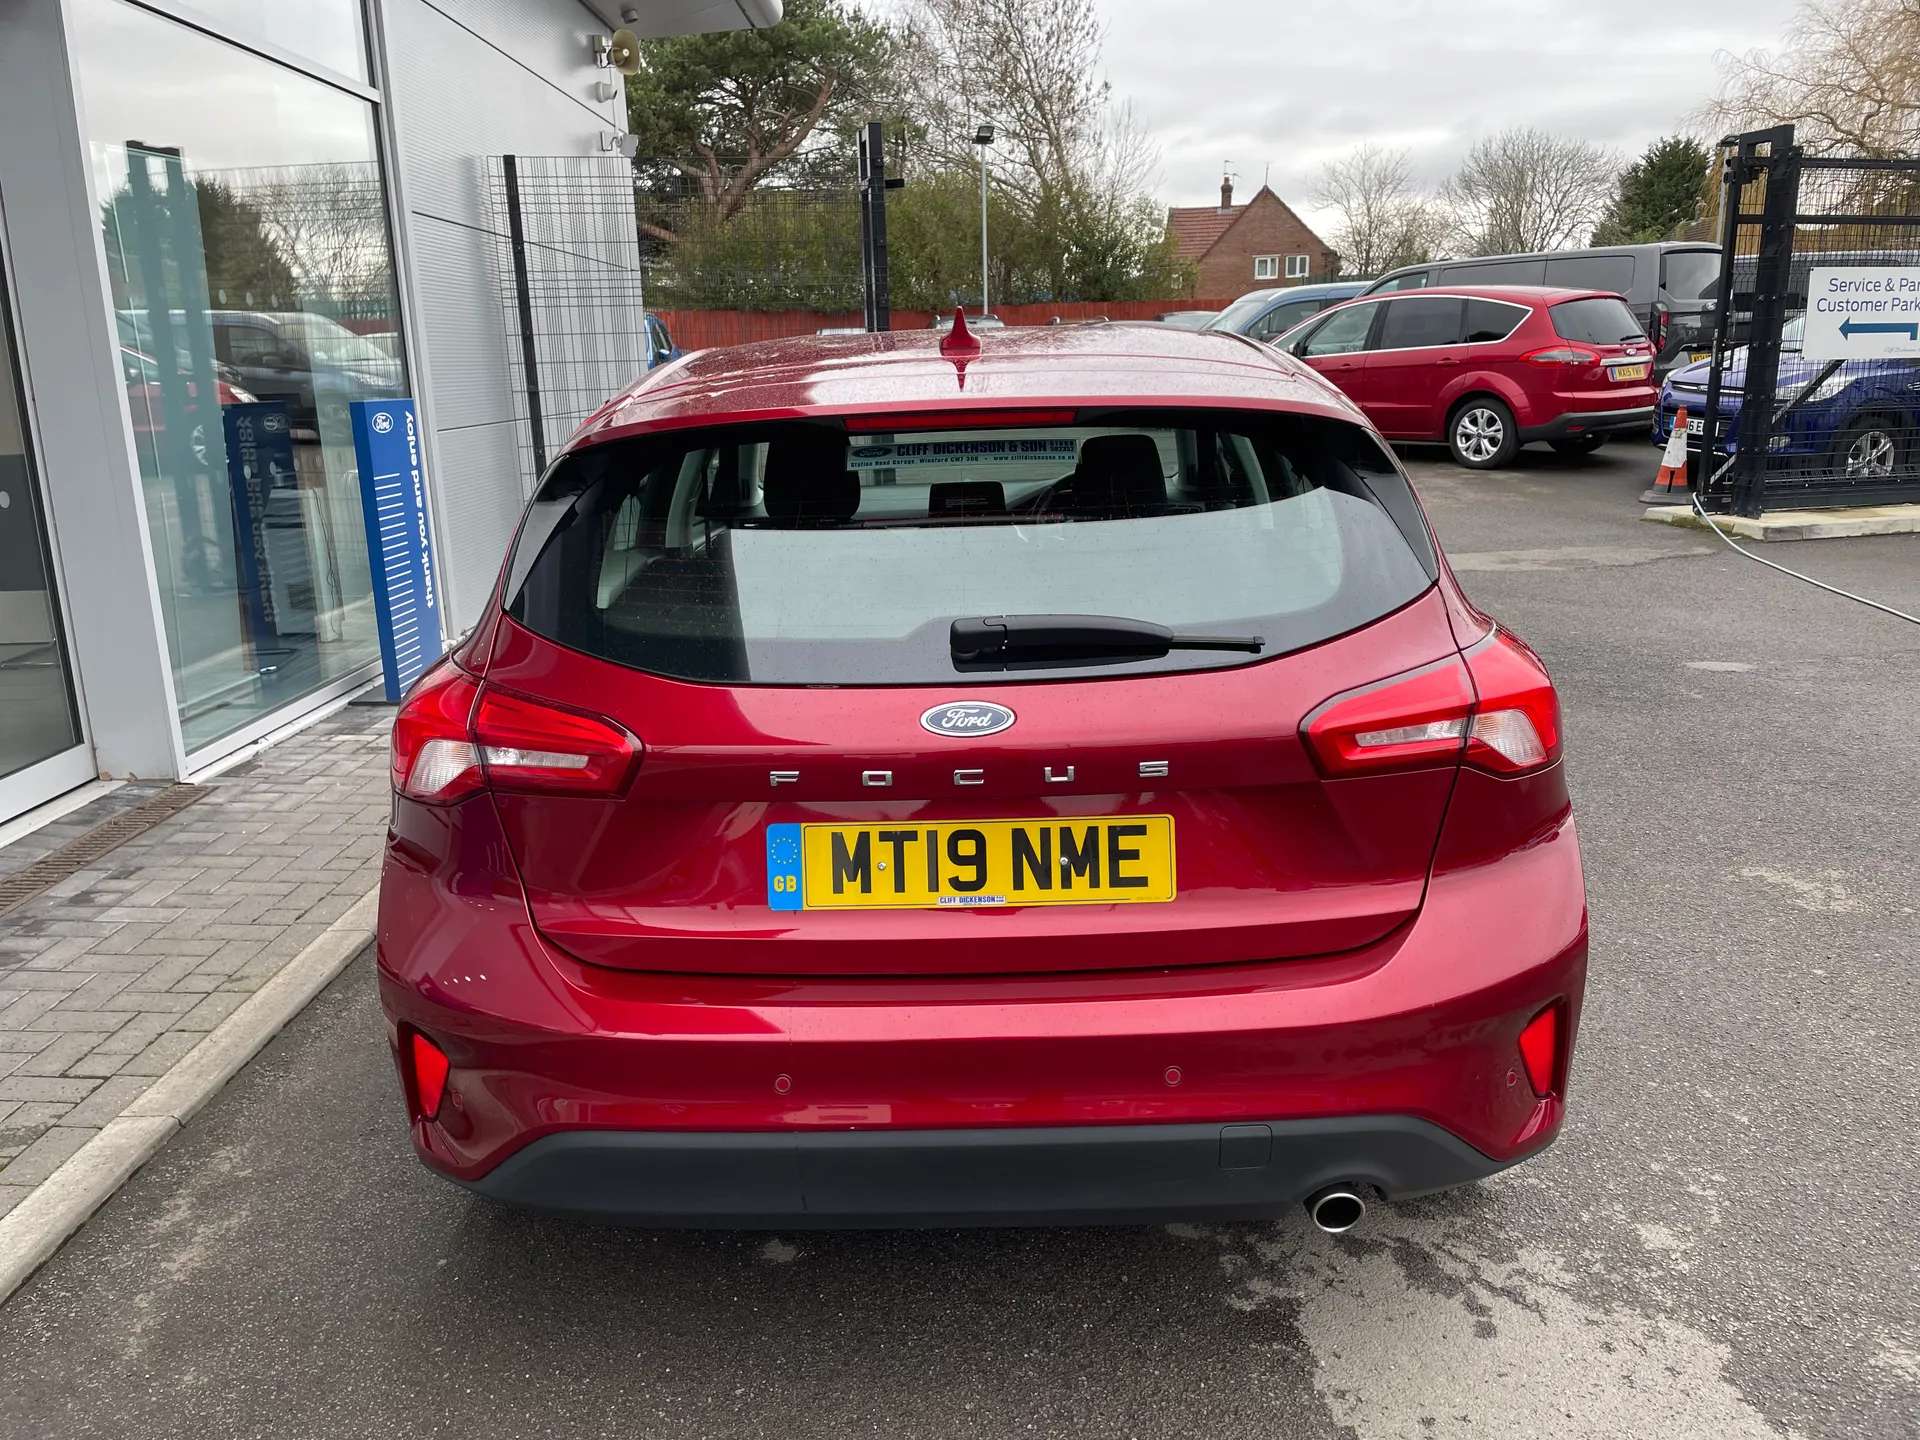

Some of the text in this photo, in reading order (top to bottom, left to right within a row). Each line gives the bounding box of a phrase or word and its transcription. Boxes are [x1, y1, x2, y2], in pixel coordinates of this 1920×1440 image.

[1828, 277, 1881, 292] Service
[1884, 277, 1895, 292] &
[1816, 297, 1888, 312] Customer
[896, 443, 931, 457] CLIFF
[933, 440, 1006, 456] DICKENSON
[1008, 440, 1018, 452] &
[1020, 439, 1047, 452] SON
[405, 410, 435, 609] thank you and enjoy
[941, 707, 993, 729] Ford
[769, 760, 1170, 787] FOCUS
[831, 824, 1149, 895] MT19 NME
[773, 874, 797, 893] GB
[940, 896, 956, 904] CLIFF
[959, 895, 996, 904] DICKENSON
